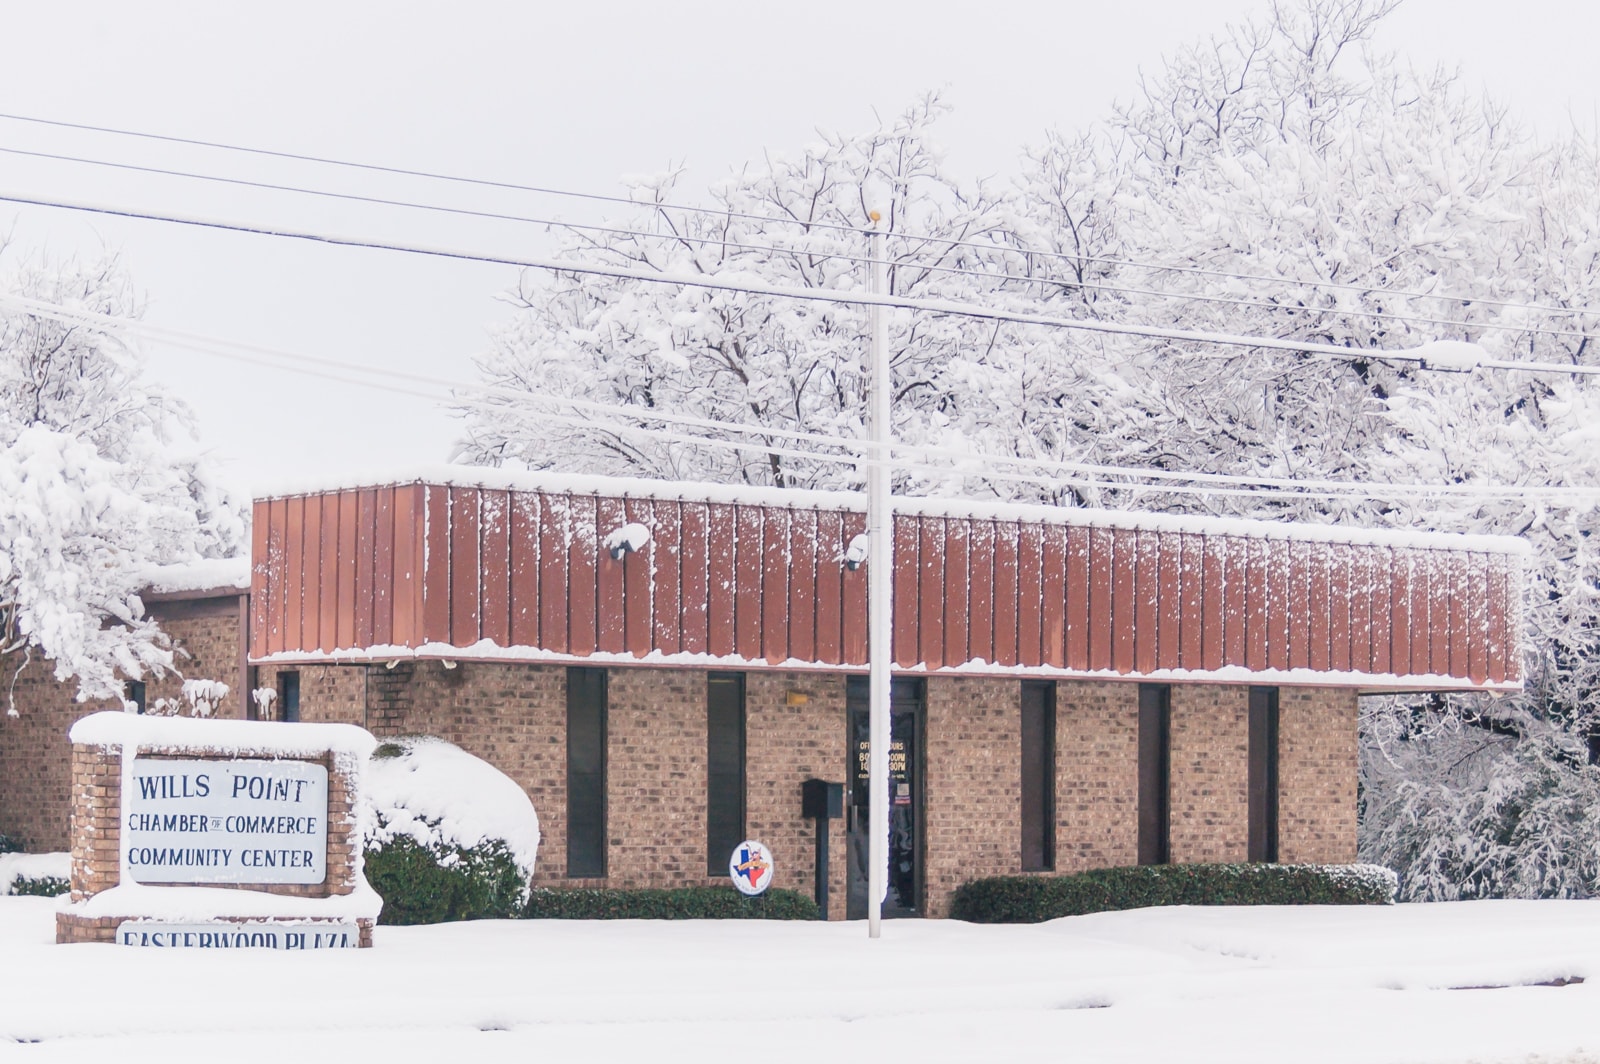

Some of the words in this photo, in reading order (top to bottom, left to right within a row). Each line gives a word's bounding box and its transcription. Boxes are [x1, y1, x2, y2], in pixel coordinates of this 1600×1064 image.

[138, 774, 210, 800] WILLS
[232, 775, 308, 802] POINT
[128, 813, 208, 832] CHAMBER
[225, 815, 317, 834] COMMERCE
[128, 847, 232, 866] COMMUNITY
[241, 849, 313, 867] CENTER
